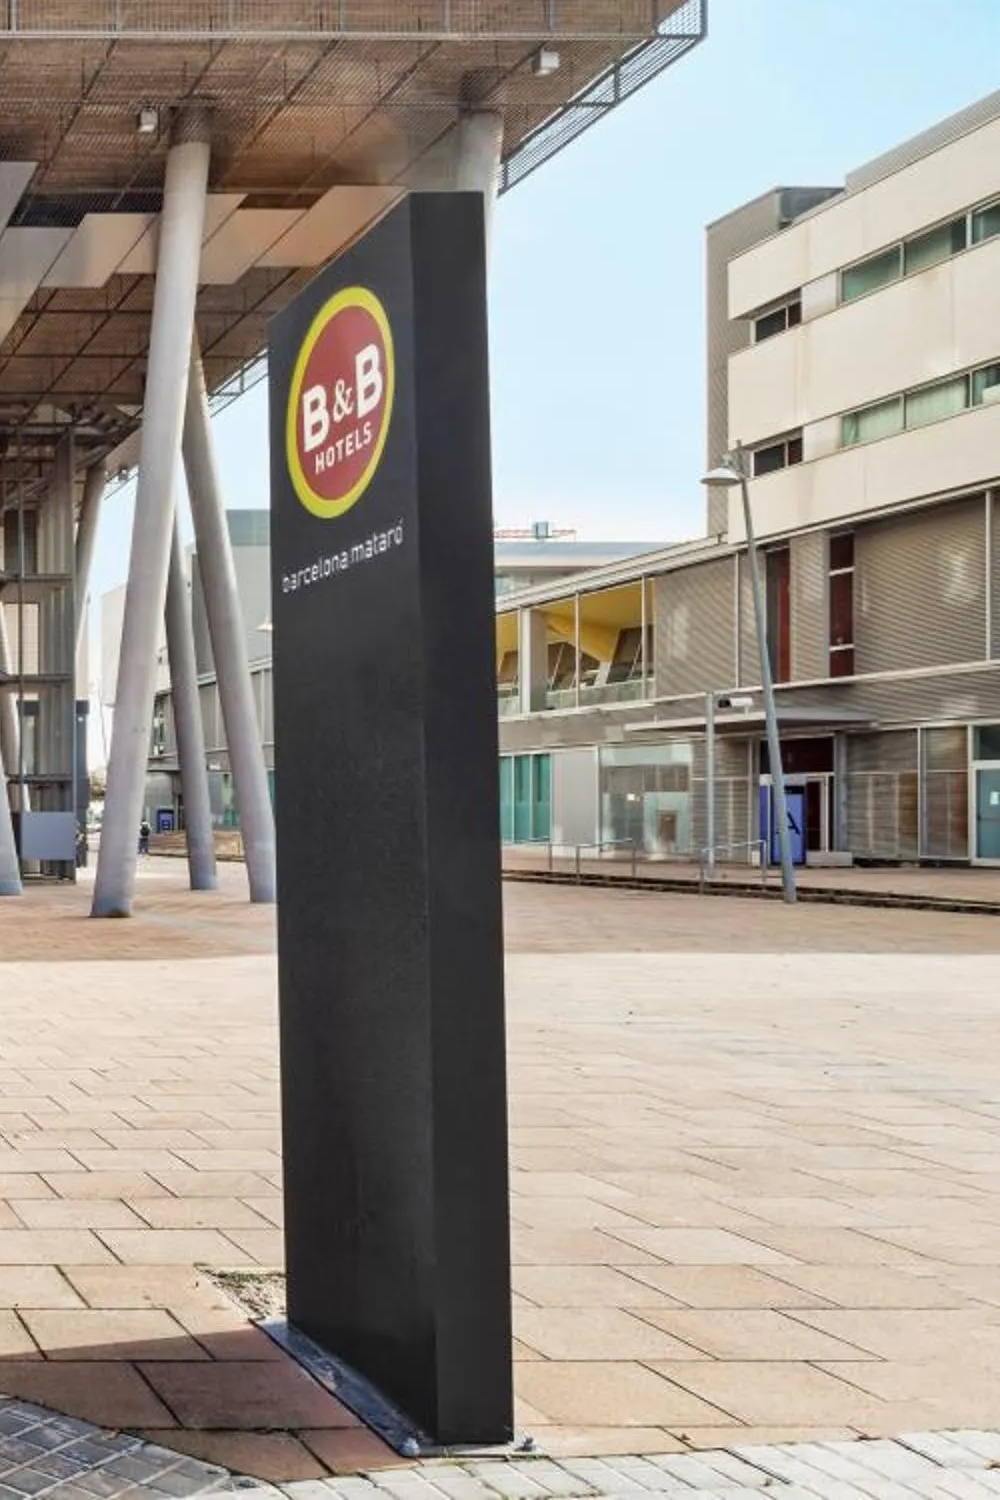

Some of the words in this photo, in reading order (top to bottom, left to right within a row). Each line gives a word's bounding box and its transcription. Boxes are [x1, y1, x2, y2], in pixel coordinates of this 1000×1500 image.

[301, 343, 384, 453] B&B
[315, 421, 373, 475] HOTELS
[282, 551, 349, 593] barcelona
